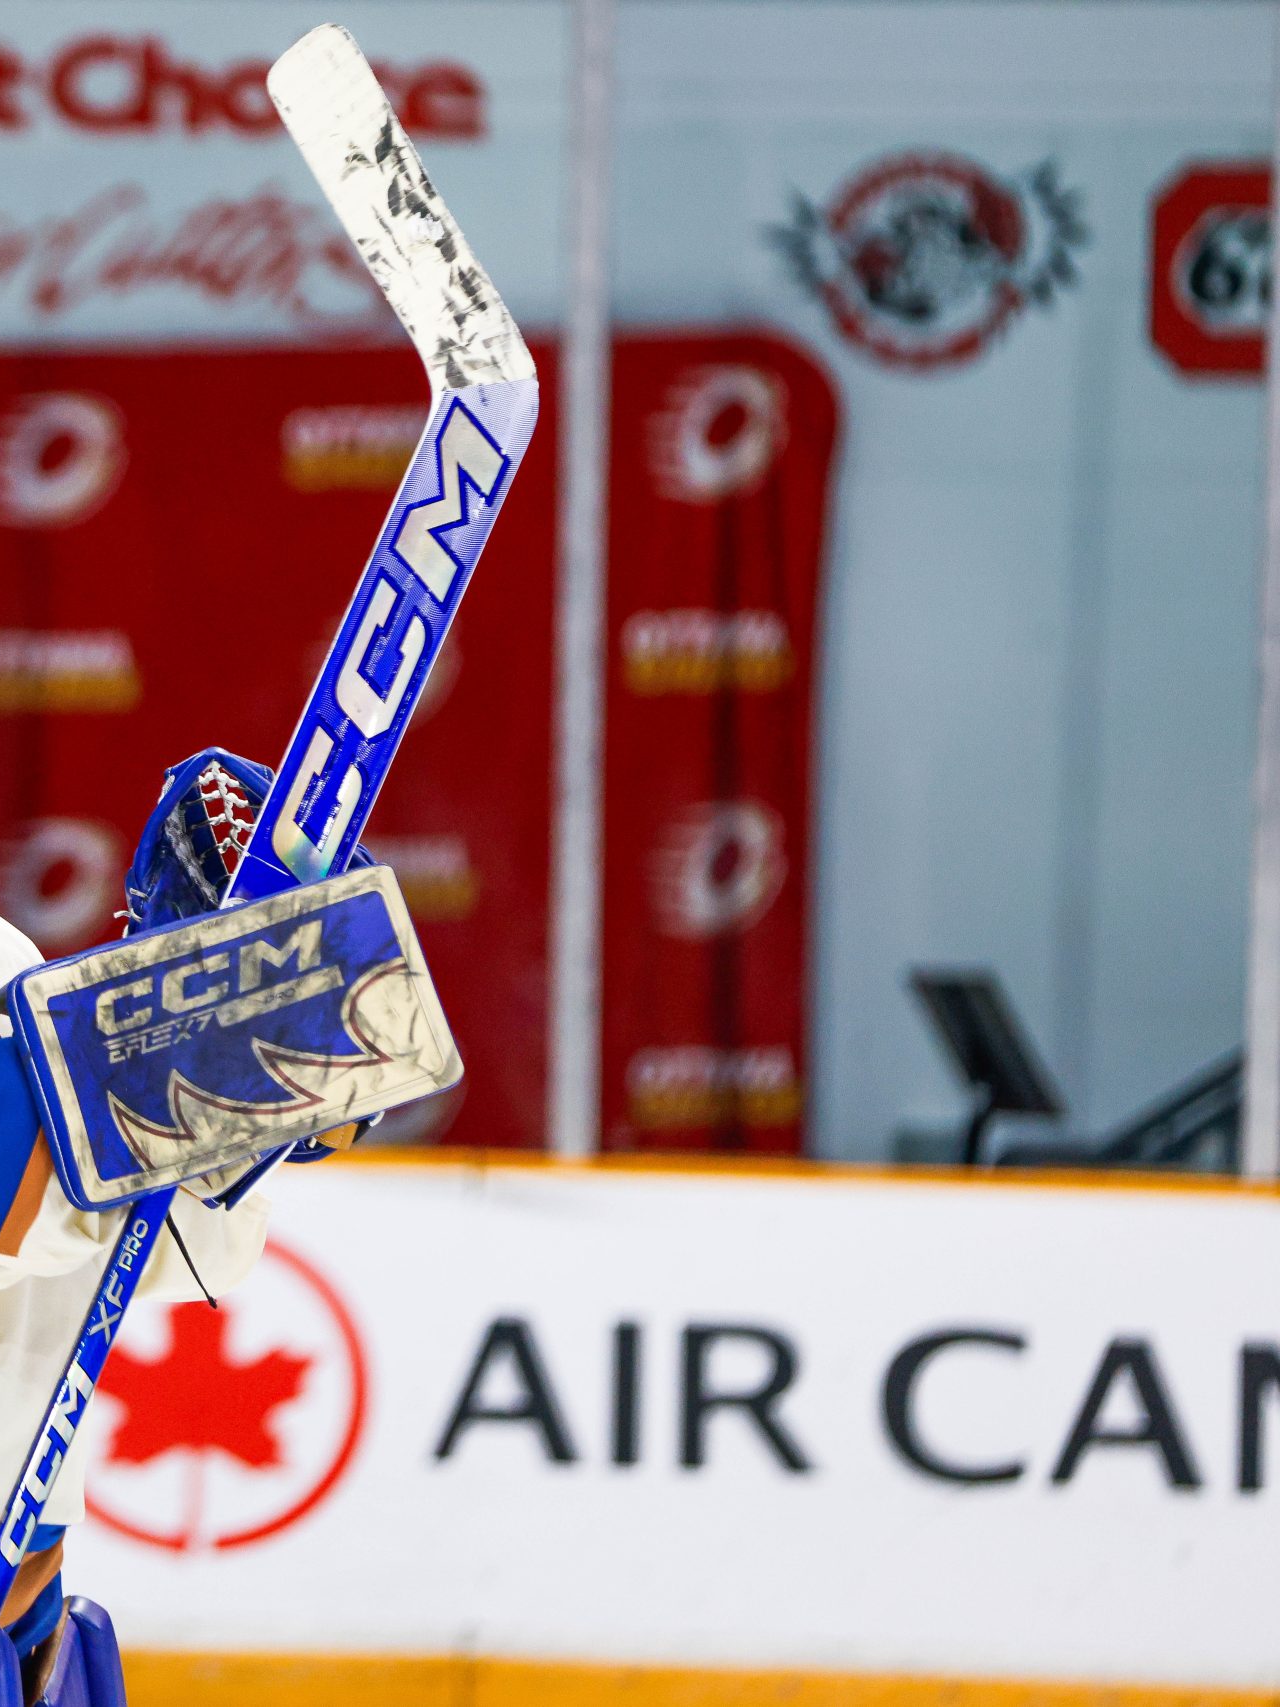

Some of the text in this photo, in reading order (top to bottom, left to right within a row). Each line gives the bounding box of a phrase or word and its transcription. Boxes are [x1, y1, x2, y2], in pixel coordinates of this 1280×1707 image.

[272, 400, 510, 882] CCM
[96, 919, 323, 1037] CCM
[0, 1359, 95, 1568] CCM
[89, 1270, 125, 1347] XF
[118, 1217, 150, 1272] PRO
[434, 1315, 816, 1476] AIR
